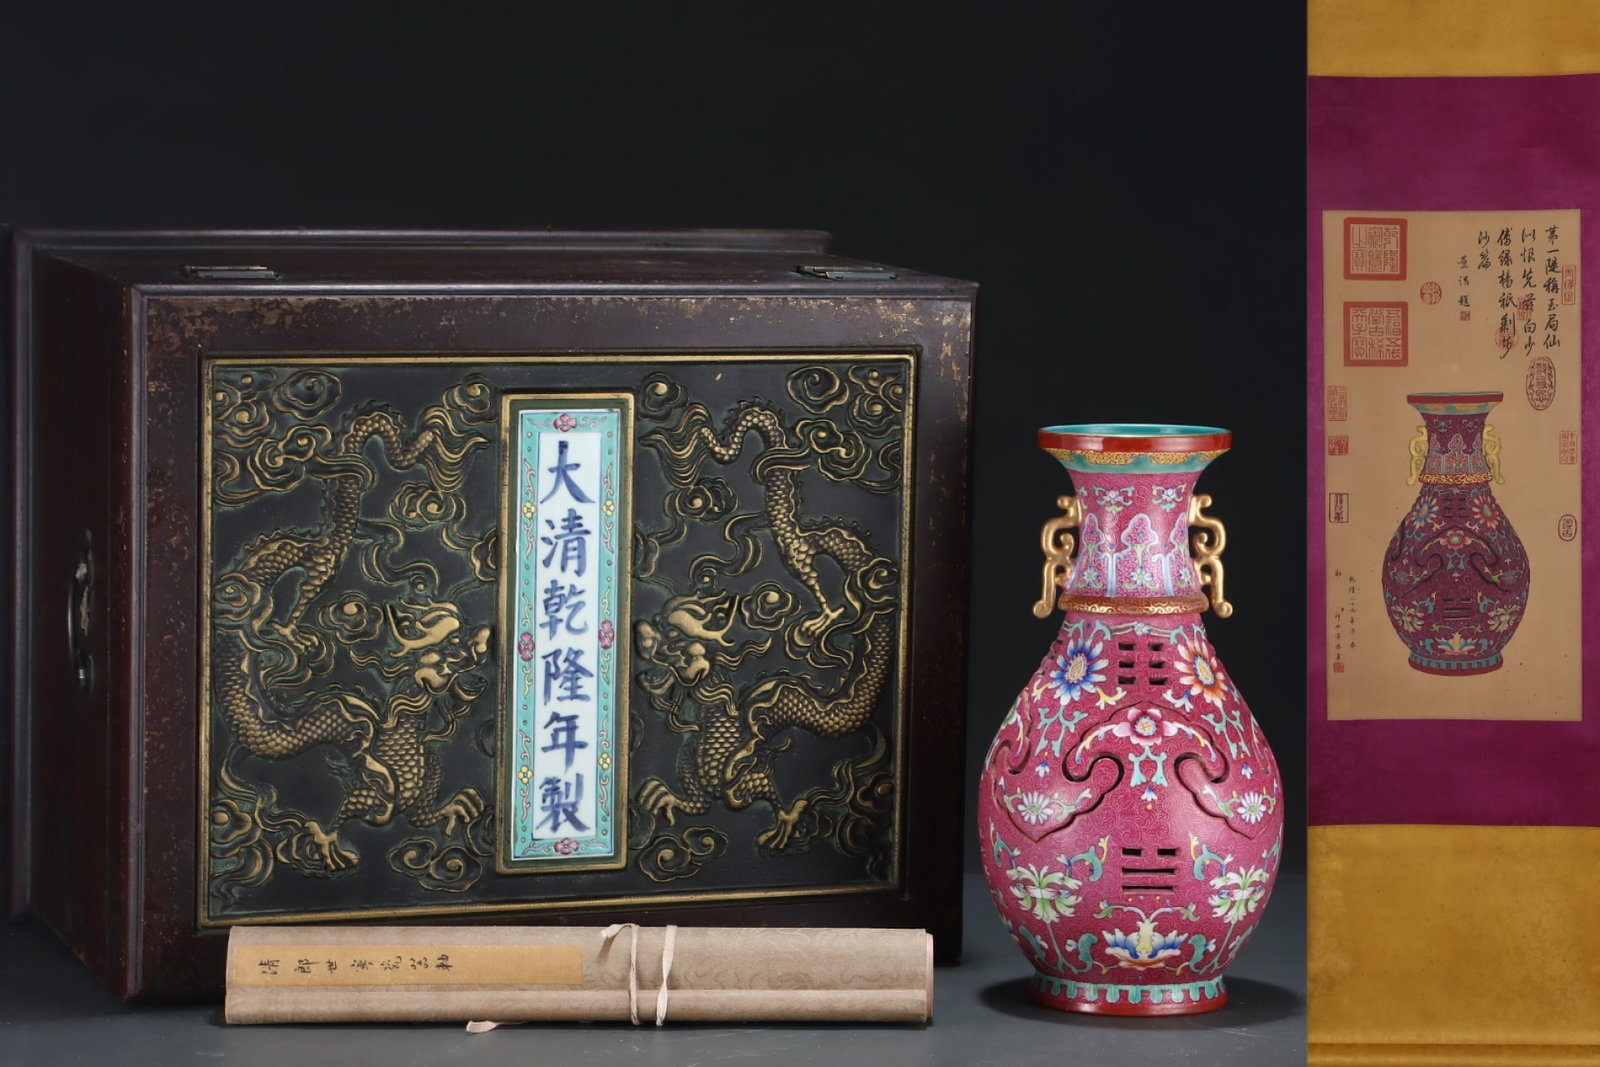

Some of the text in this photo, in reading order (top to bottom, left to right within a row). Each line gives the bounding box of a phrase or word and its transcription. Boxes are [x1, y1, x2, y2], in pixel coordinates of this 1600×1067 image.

[536, 440, 595, 833] 大清乾隆年製
